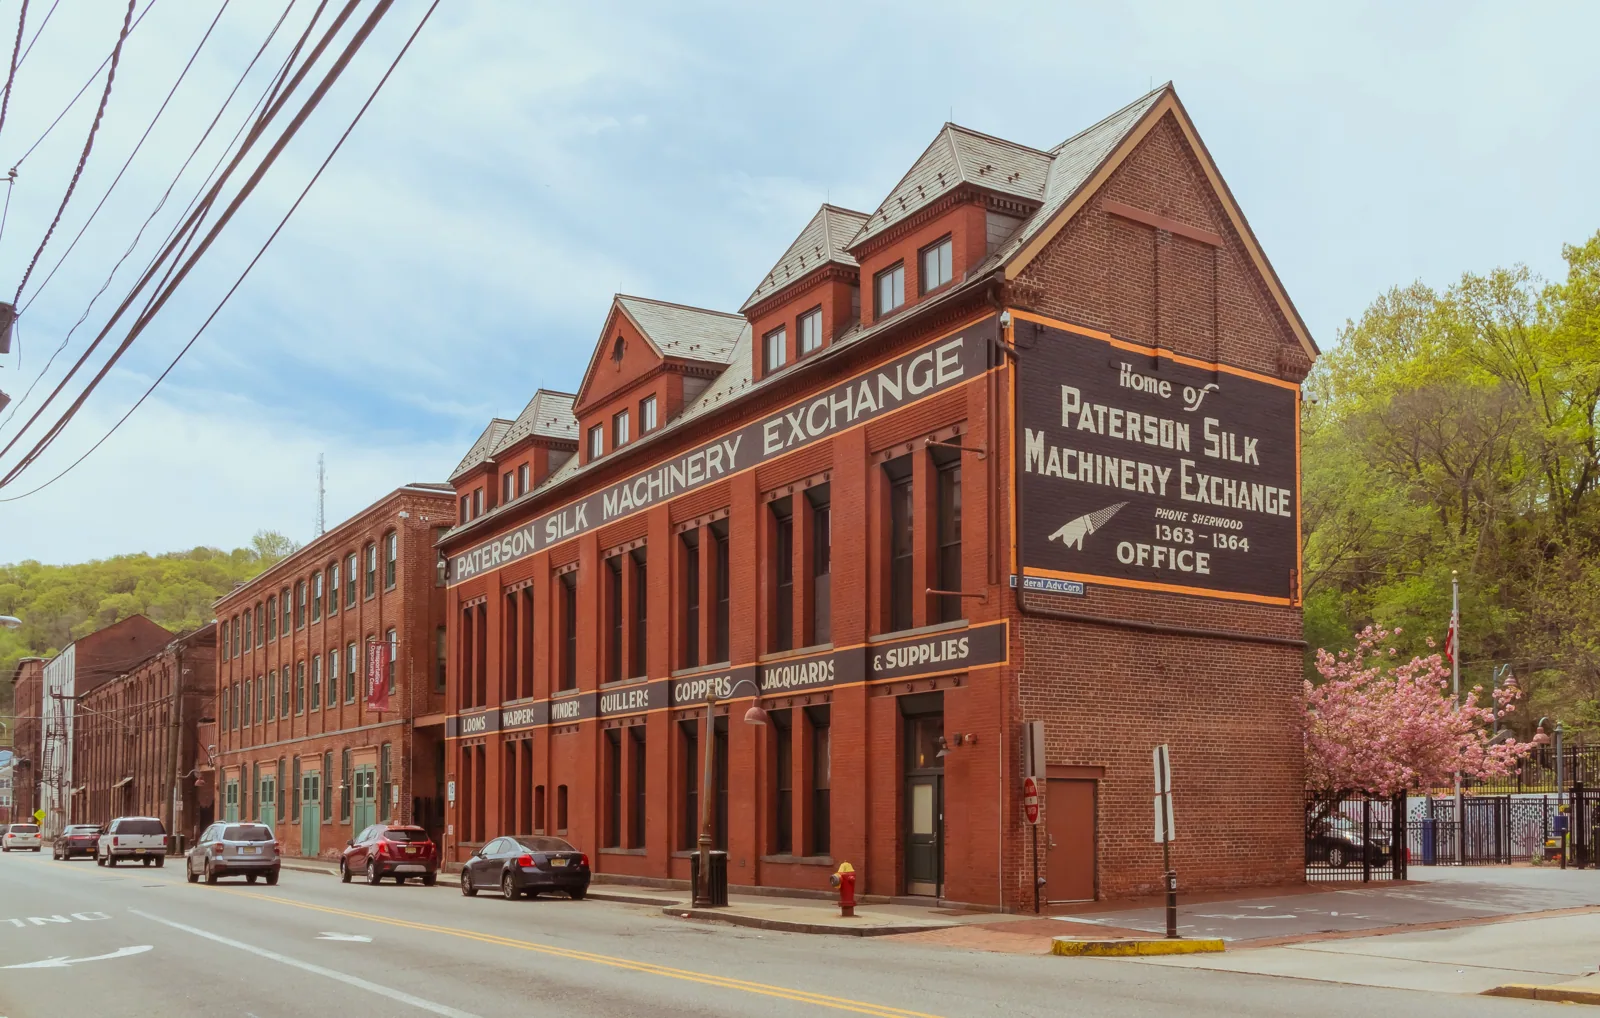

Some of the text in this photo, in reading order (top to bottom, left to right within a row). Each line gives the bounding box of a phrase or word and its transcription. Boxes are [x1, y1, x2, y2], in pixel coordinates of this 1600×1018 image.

[1120, 362, 1220, 411] Home of
[1061, 384, 1260, 466] PATERSON SILK
[457, 337, 964, 580] PATERSON SILK MACHINERY EXCHANGE
[1024, 427, 1291, 517] MACHINERY EXCHANGE
[1155, 507, 1244, 531] PHONE SHERWOOD
[1155, 524, 1195, 545] 1363
[1212, 532, 1250, 553] 1364
[1116, 540, 1211, 575] OFFICE
[463, 715, 486, 733] LOOMS
[600, 689, 649, 713] QUILLERS
[761, 659, 834, 690] JACQUARDS
[873, 654, 883, 671] &
[885, 635, 970, 670] SUPPLIES
